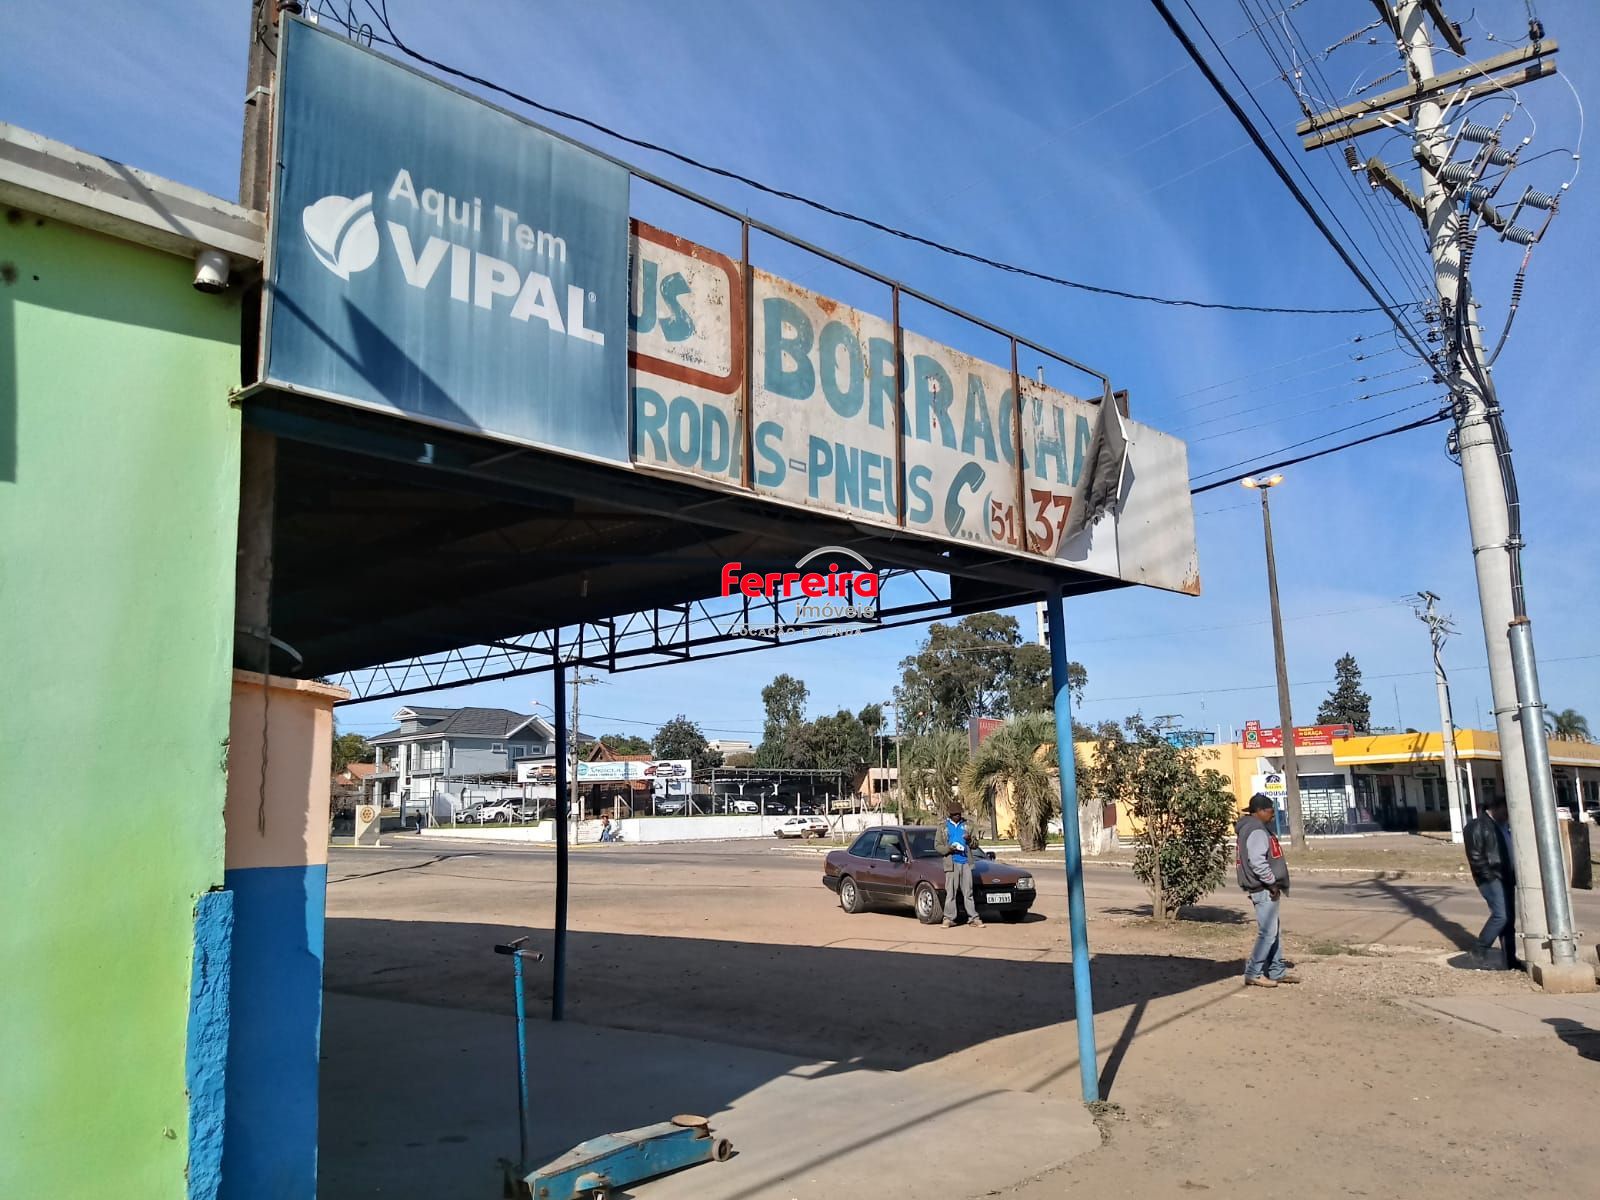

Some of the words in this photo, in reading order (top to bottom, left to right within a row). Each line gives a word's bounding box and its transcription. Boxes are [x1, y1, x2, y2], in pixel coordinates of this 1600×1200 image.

[388, 168, 481, 232] Aqui
[494, 205, 567, 263] Tem
[386, 220, 605, 346] VIPAL
